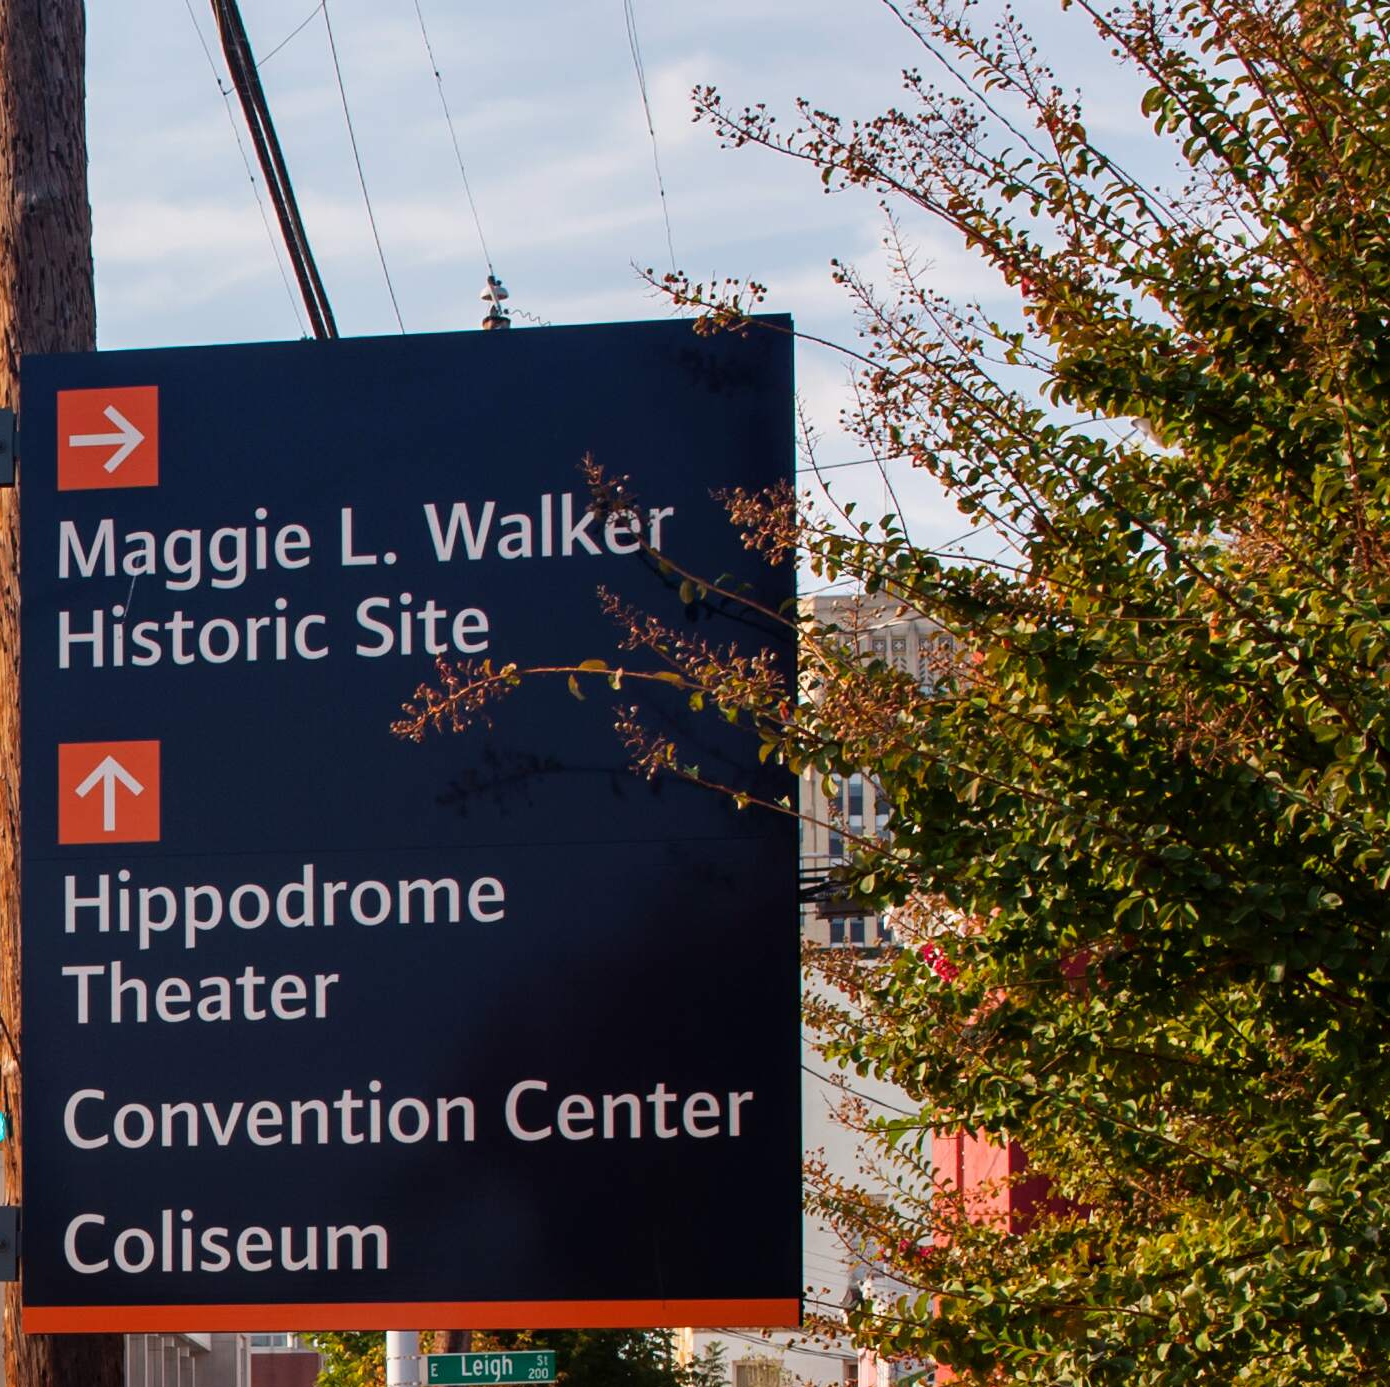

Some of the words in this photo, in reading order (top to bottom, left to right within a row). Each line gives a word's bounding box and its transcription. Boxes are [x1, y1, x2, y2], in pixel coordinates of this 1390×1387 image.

[59, 507, 311, 591] Maggie
[341, 507, 397, 567] L.
[423, 492, 675, 562] Walker
[59, 597, 329, 669] Historic
[356, 593, 489, 657] Site
[64, 863, 505, 950] Hippodrome
[61, 960, 339, 1024] Theater
[63, 1079, 476, 1149] Convention
[505, 1078, 754, 1142] Center
[64, 1209, 389, 1274] Coliseum
[430, 1363, 439, 1378] E
[461, 1355, 513, 1382] Leigh
[536, 1354, 548, 1366] St
[528, 1367, 549, 1379] 200
